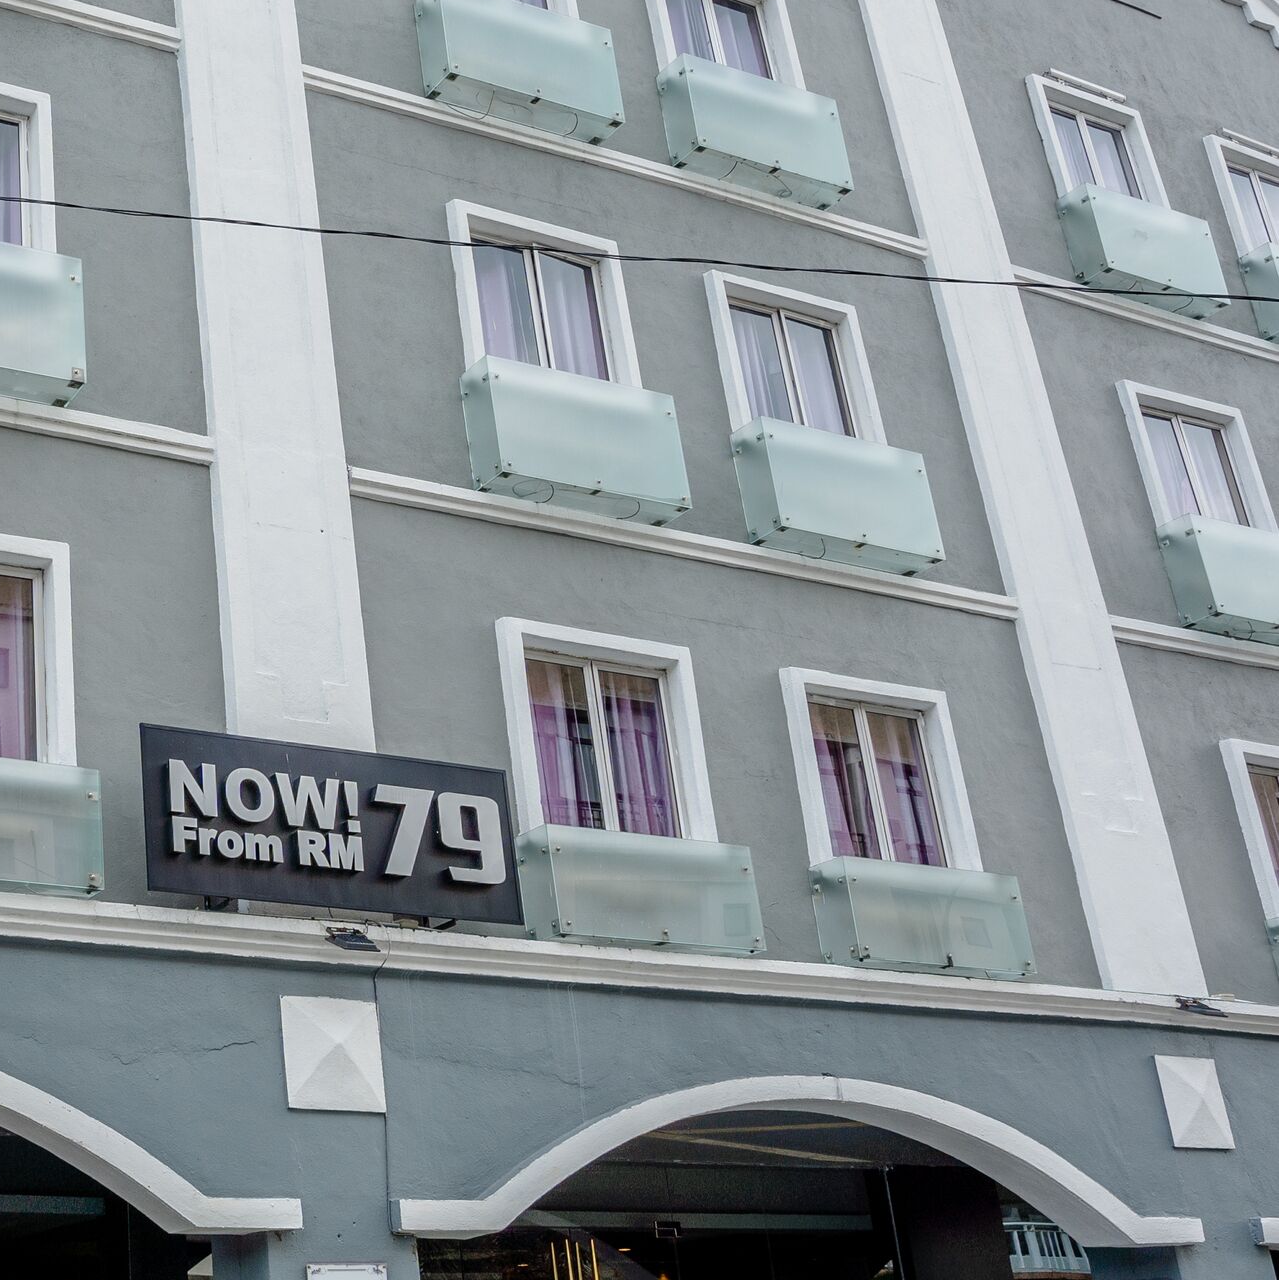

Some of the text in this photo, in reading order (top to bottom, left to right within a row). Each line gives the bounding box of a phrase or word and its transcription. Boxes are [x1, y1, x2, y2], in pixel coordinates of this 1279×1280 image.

[166, 758, 361, 833] NOW!
[170, 815, 365, 872] From RM
[373, 783, 507, 885] 79
